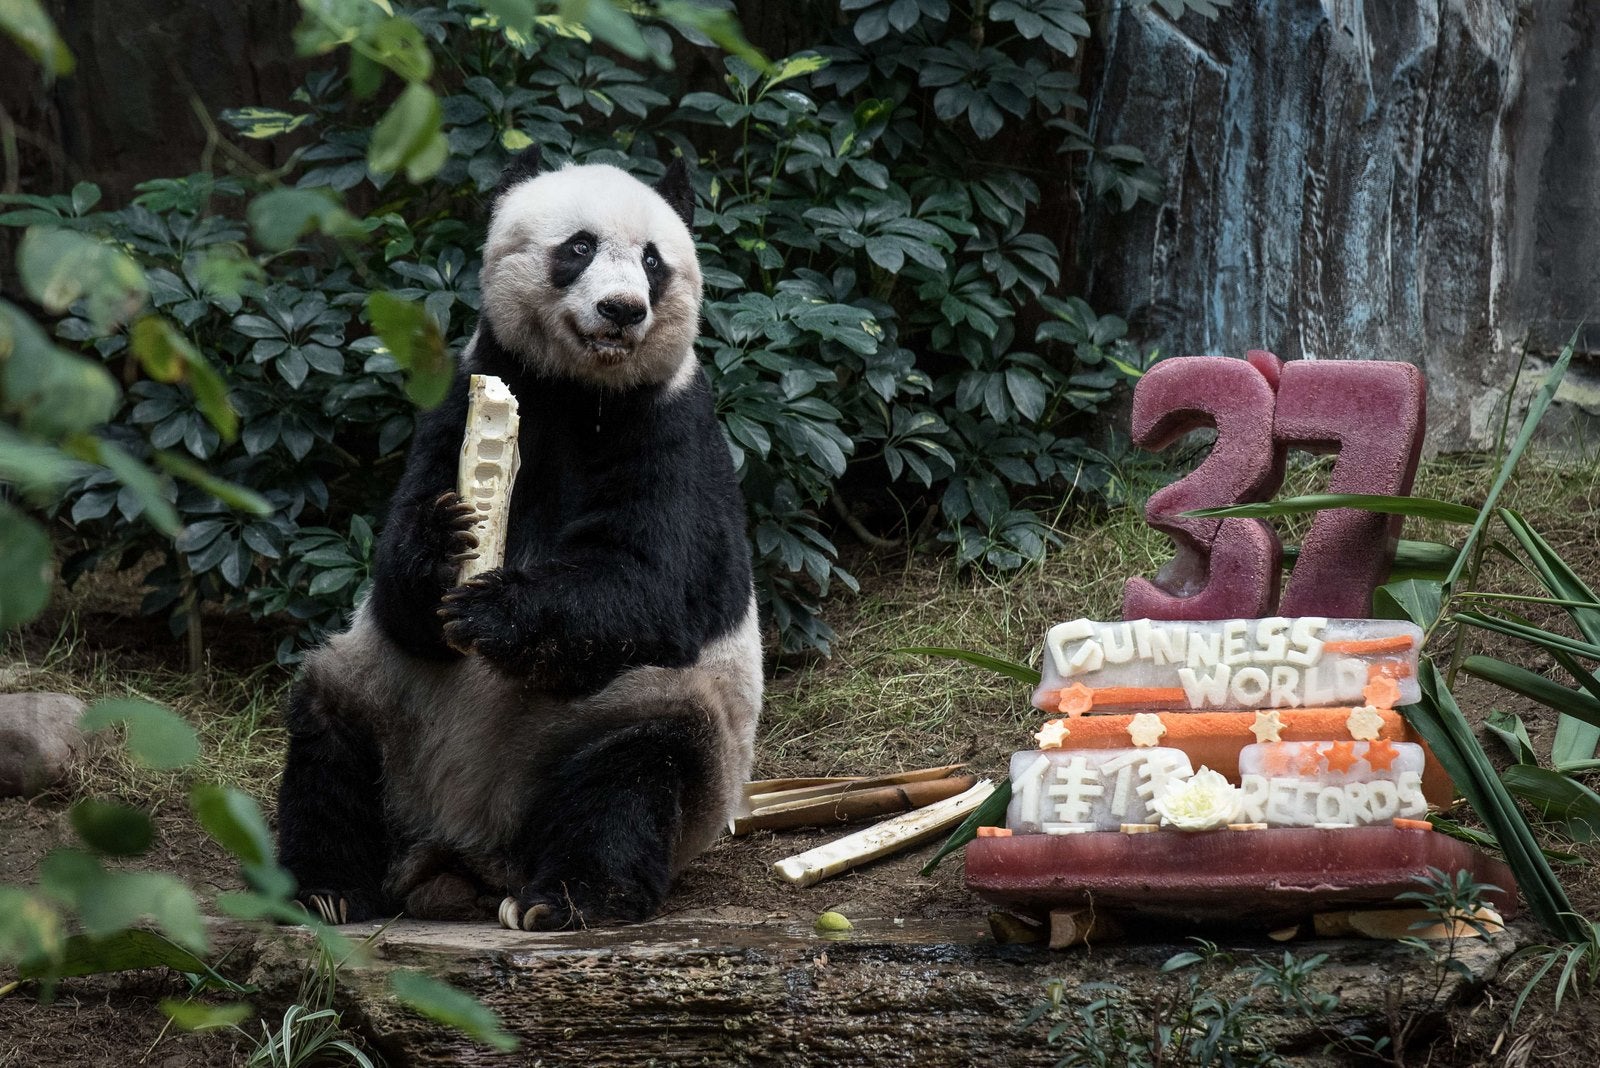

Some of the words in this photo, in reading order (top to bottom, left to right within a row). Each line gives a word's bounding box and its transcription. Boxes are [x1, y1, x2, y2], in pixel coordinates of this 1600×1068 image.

[1122, 356, 1427, 620] 37
[1047, 617, 1327, 677] GUINNESS
[1178, 662, 1369, 709] WORLD
[1238, 771, 1428, 828] RECORDS
